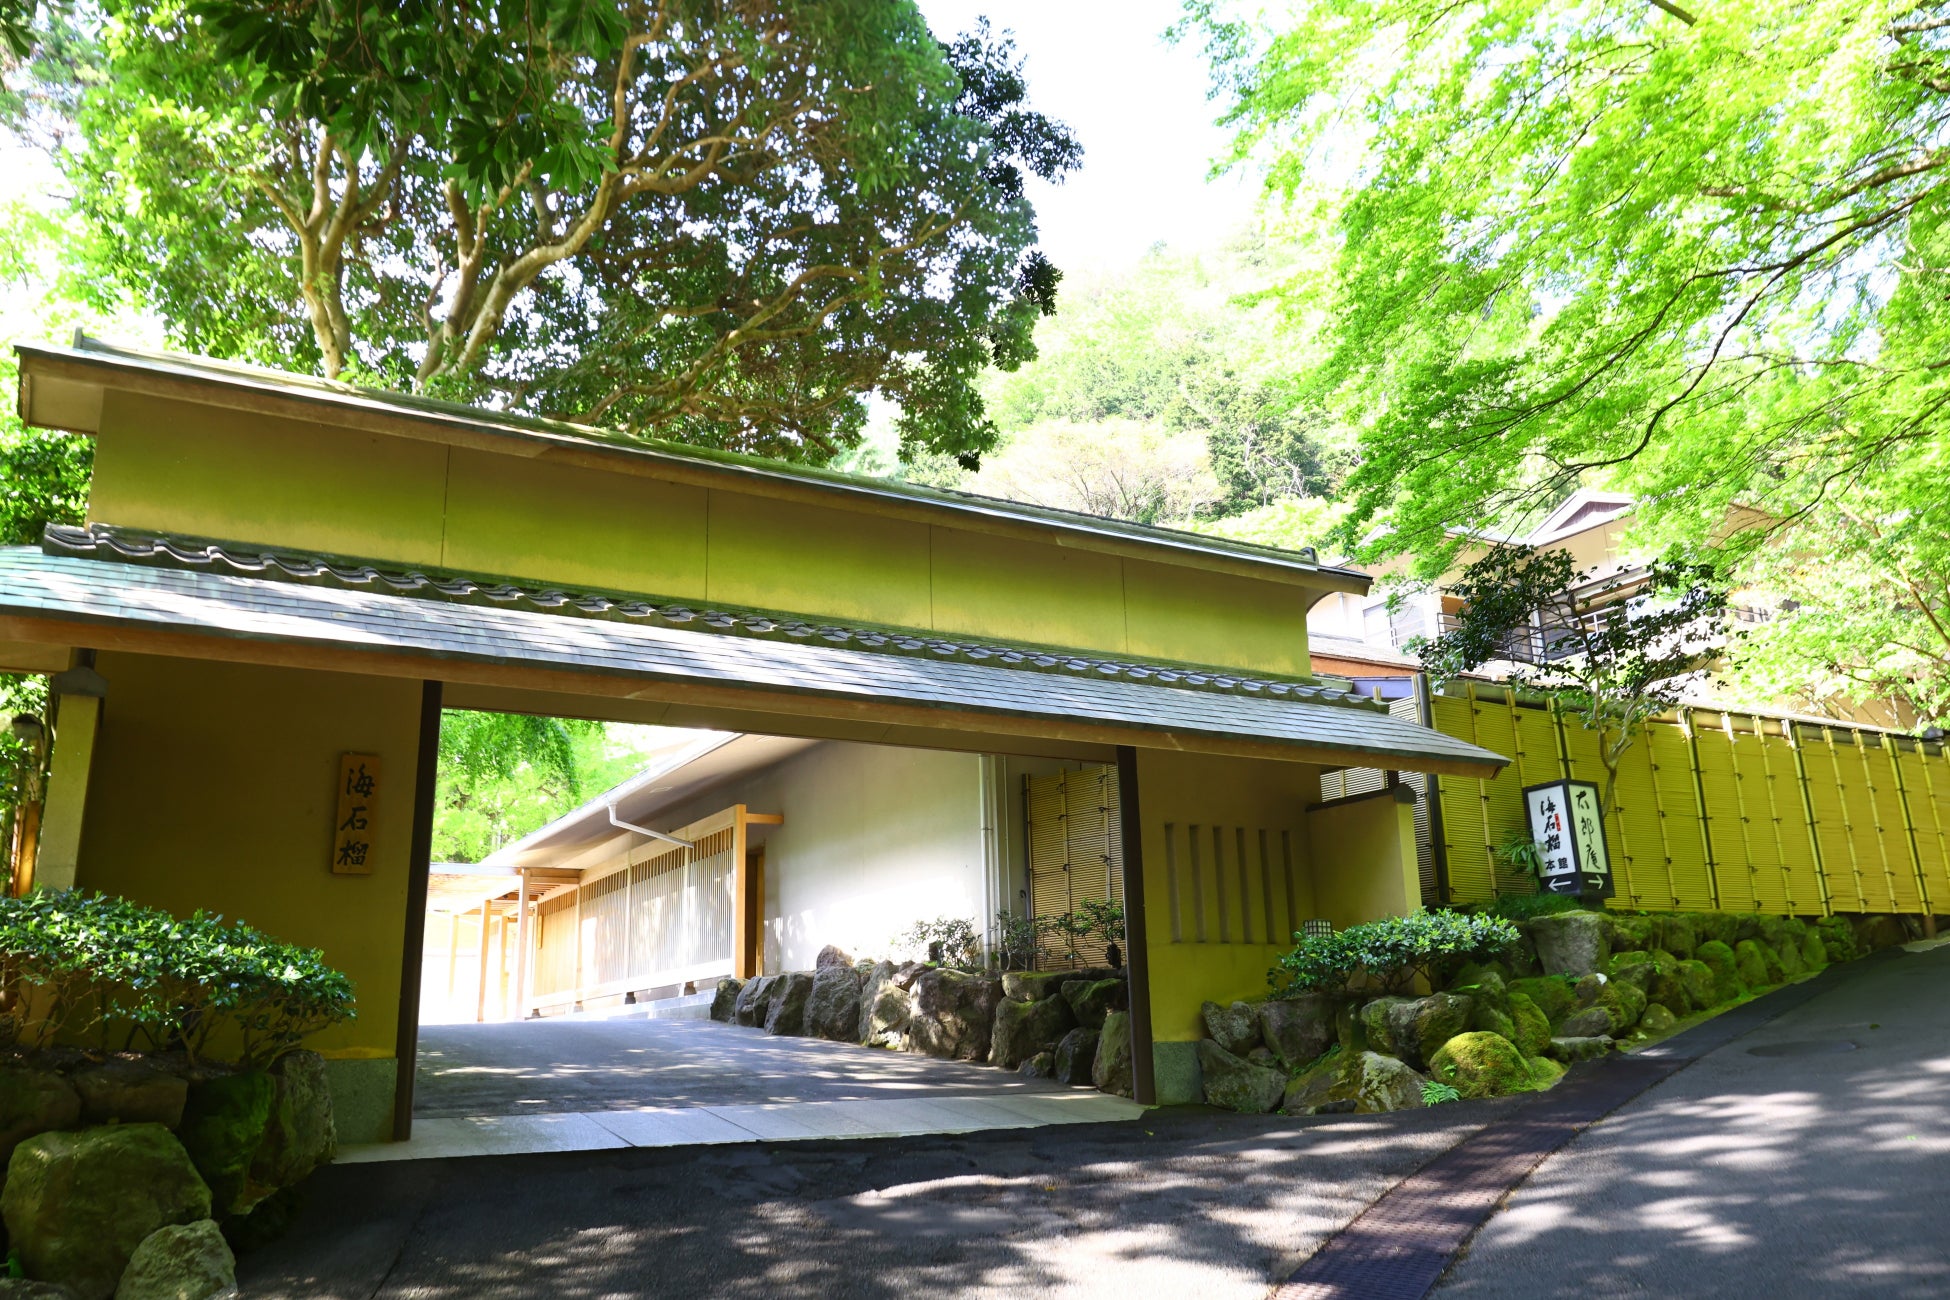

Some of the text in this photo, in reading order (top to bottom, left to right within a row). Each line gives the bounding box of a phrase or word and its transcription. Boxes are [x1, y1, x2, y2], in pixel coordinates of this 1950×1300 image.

[337, 763, 375, 866] 海石榴
[1540, 796, 1560, 853] 海石榴
[1545, 857, 1568, 871] 本館
